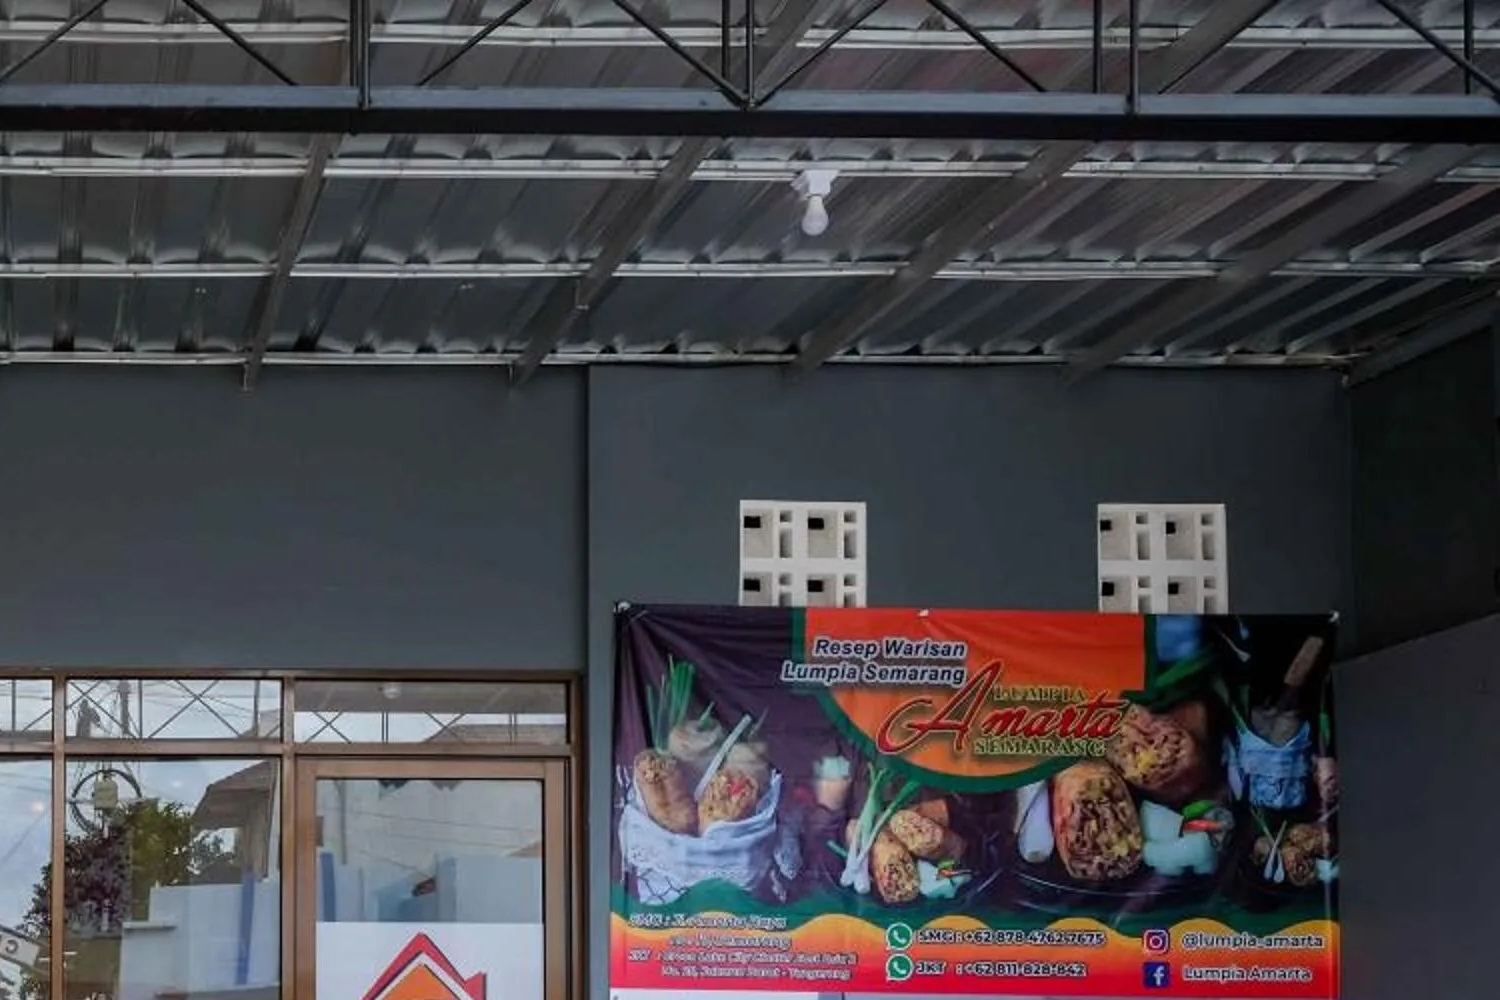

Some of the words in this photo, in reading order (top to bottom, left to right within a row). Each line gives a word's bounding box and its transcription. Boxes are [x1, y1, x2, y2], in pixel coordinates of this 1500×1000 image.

[814, 638, 878, 662] Resep
[884, 637, 966, 658] Warisan
[782, 662, 858, 686] Lumpia
[863, 663, 966, 684] Semarang
[876, 660, 1130, 753] Amarta
[974, 739, 1106, 756] SEMARANG
[1185, 966, 1245, 983] Lumpia
[1250, 966, 1312, 981] Amarta
